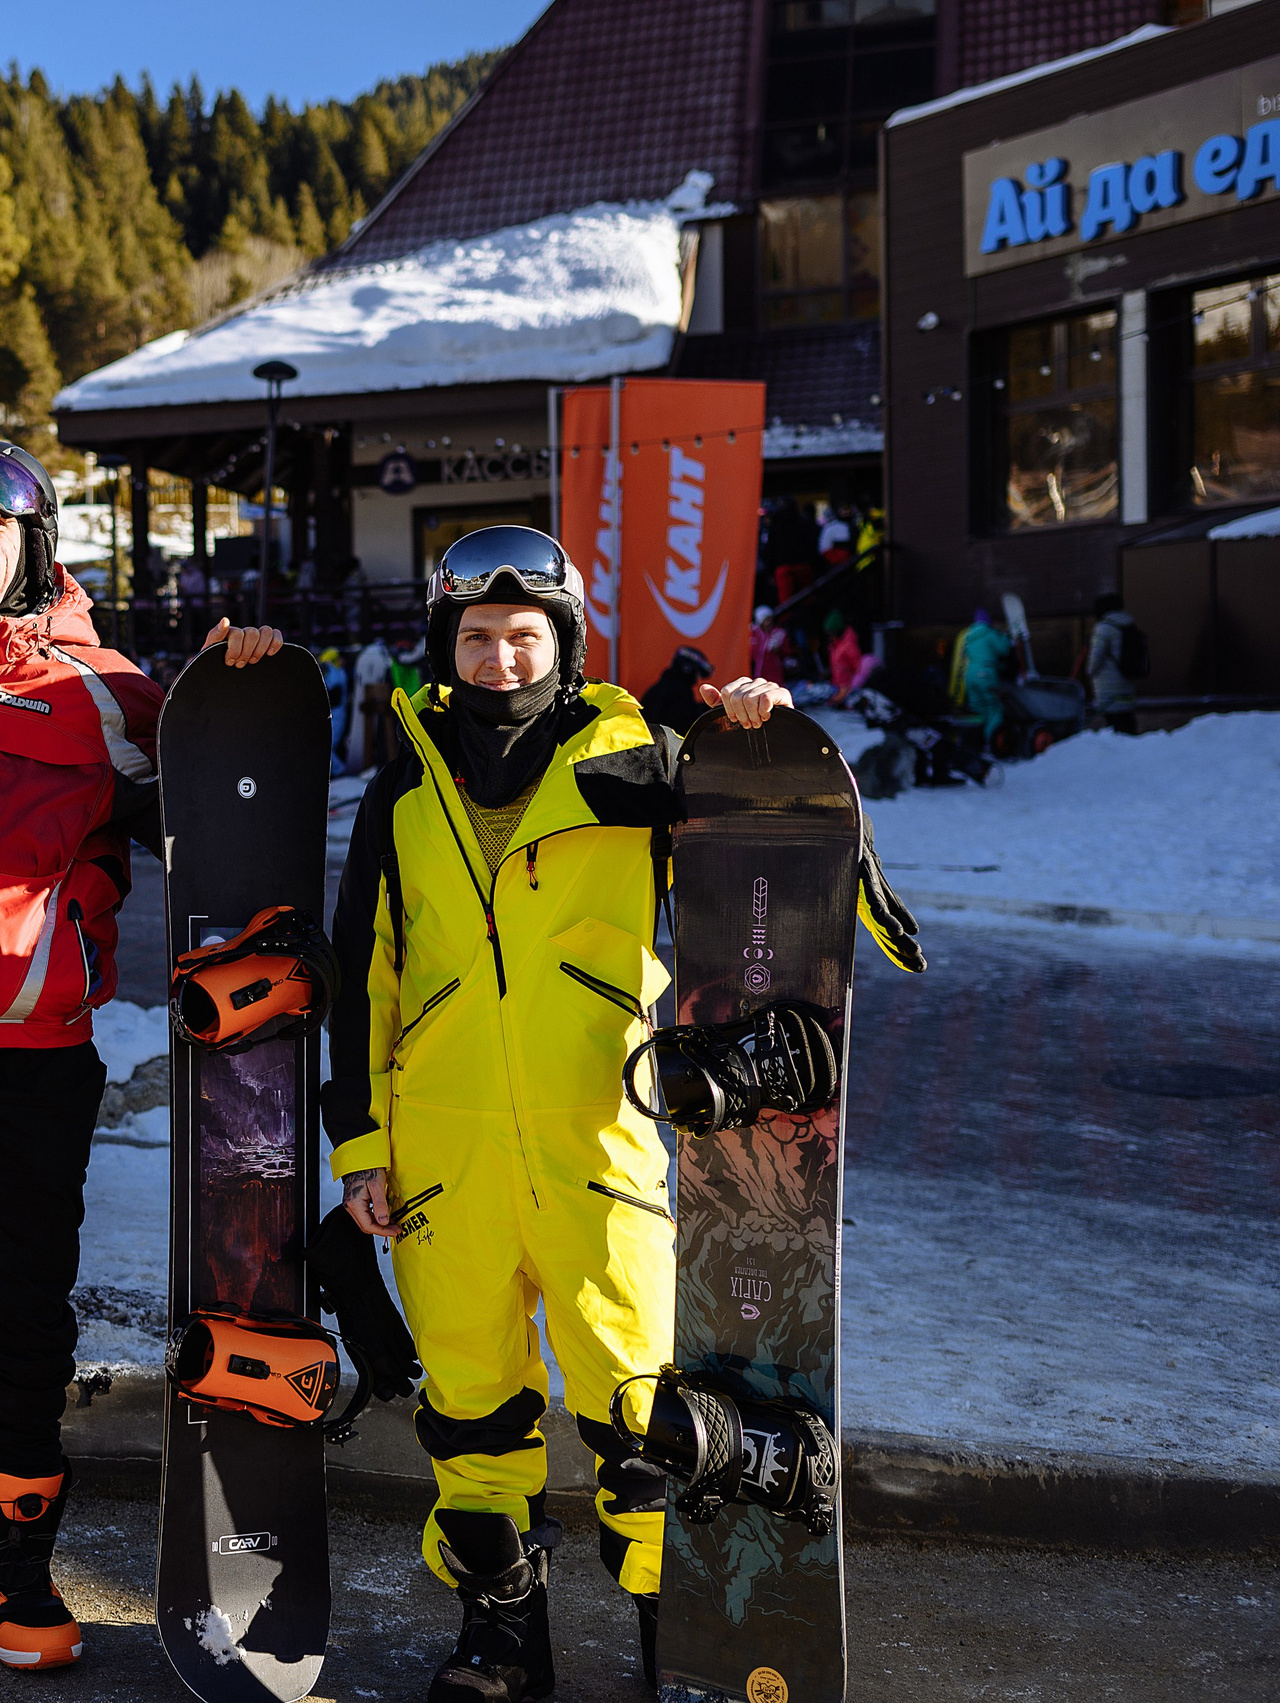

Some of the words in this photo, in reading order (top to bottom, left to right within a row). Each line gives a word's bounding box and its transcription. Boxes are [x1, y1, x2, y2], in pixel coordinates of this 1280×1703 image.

[980, 156, 1070, 255] Ай
[1080, 150, 1183, 242] да
[663, 446, 707, 608] КАНТ
[730, 1276, 773, 1302] CAPIX
[228, 1536, 261, 1551] CARV
